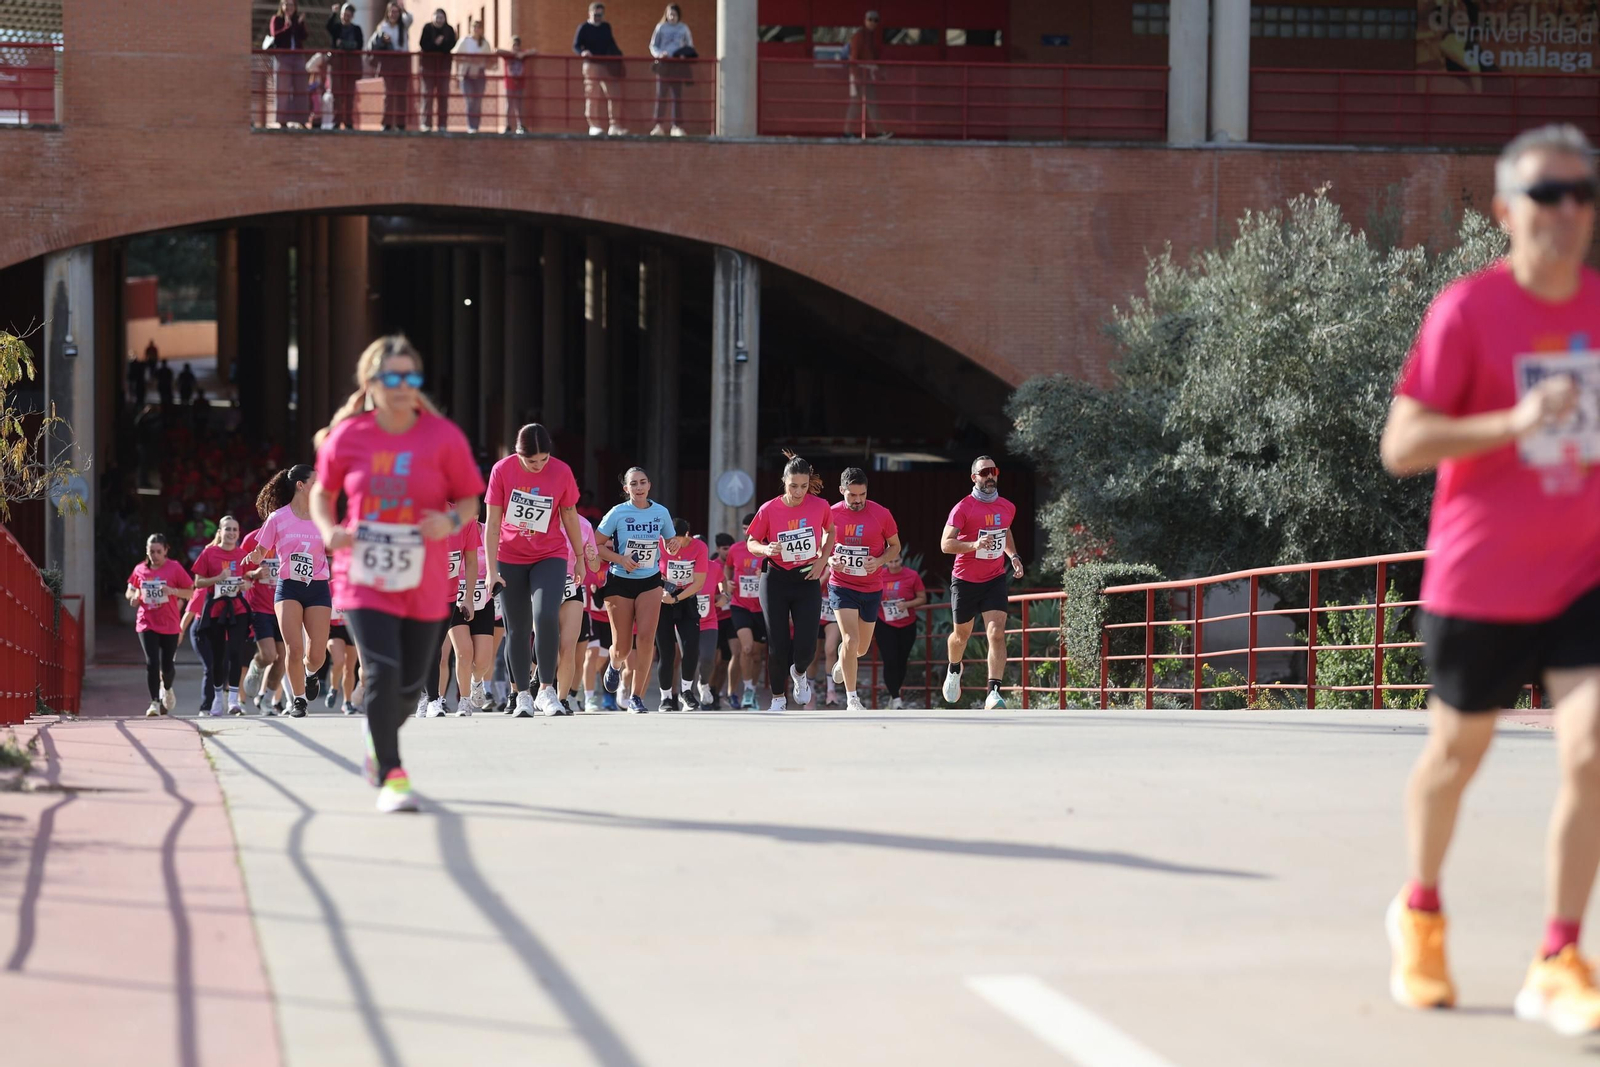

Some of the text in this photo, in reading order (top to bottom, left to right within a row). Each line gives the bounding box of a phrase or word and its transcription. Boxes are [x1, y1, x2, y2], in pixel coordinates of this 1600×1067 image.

[1428, 3, 1469, 31] de
[1455, 22, 1592, 45] universidad
[1464, 45, 1592, 73] de málaga
[371, 451, 413, 476] WE
[513, 495, 531, 505] UMA
[514, 504, 545, 521] 367
[985, 514, 1001, 526] WE
[626, 521, 659, 534] nerja
[844, 524, 864, 537] WE
[301, 541, 310, 554] 7
[786, 538, 811, 553] 446
[291, 555, 307, 563] UMA
[363, 546, 412, 573] 635
[631, 549, 652, 560] 55
[222, 560, 237, 571] WE
[744, 558, 758, 568] WE
[840, 555, 863, 567] 616
[294, 562, 314, 577] 482
[672, 569, 692, 579] 325
[743, 583, 759, 592] 458
[887, 581, 901, 590] WE
[146, 589, 164, 598] 360
